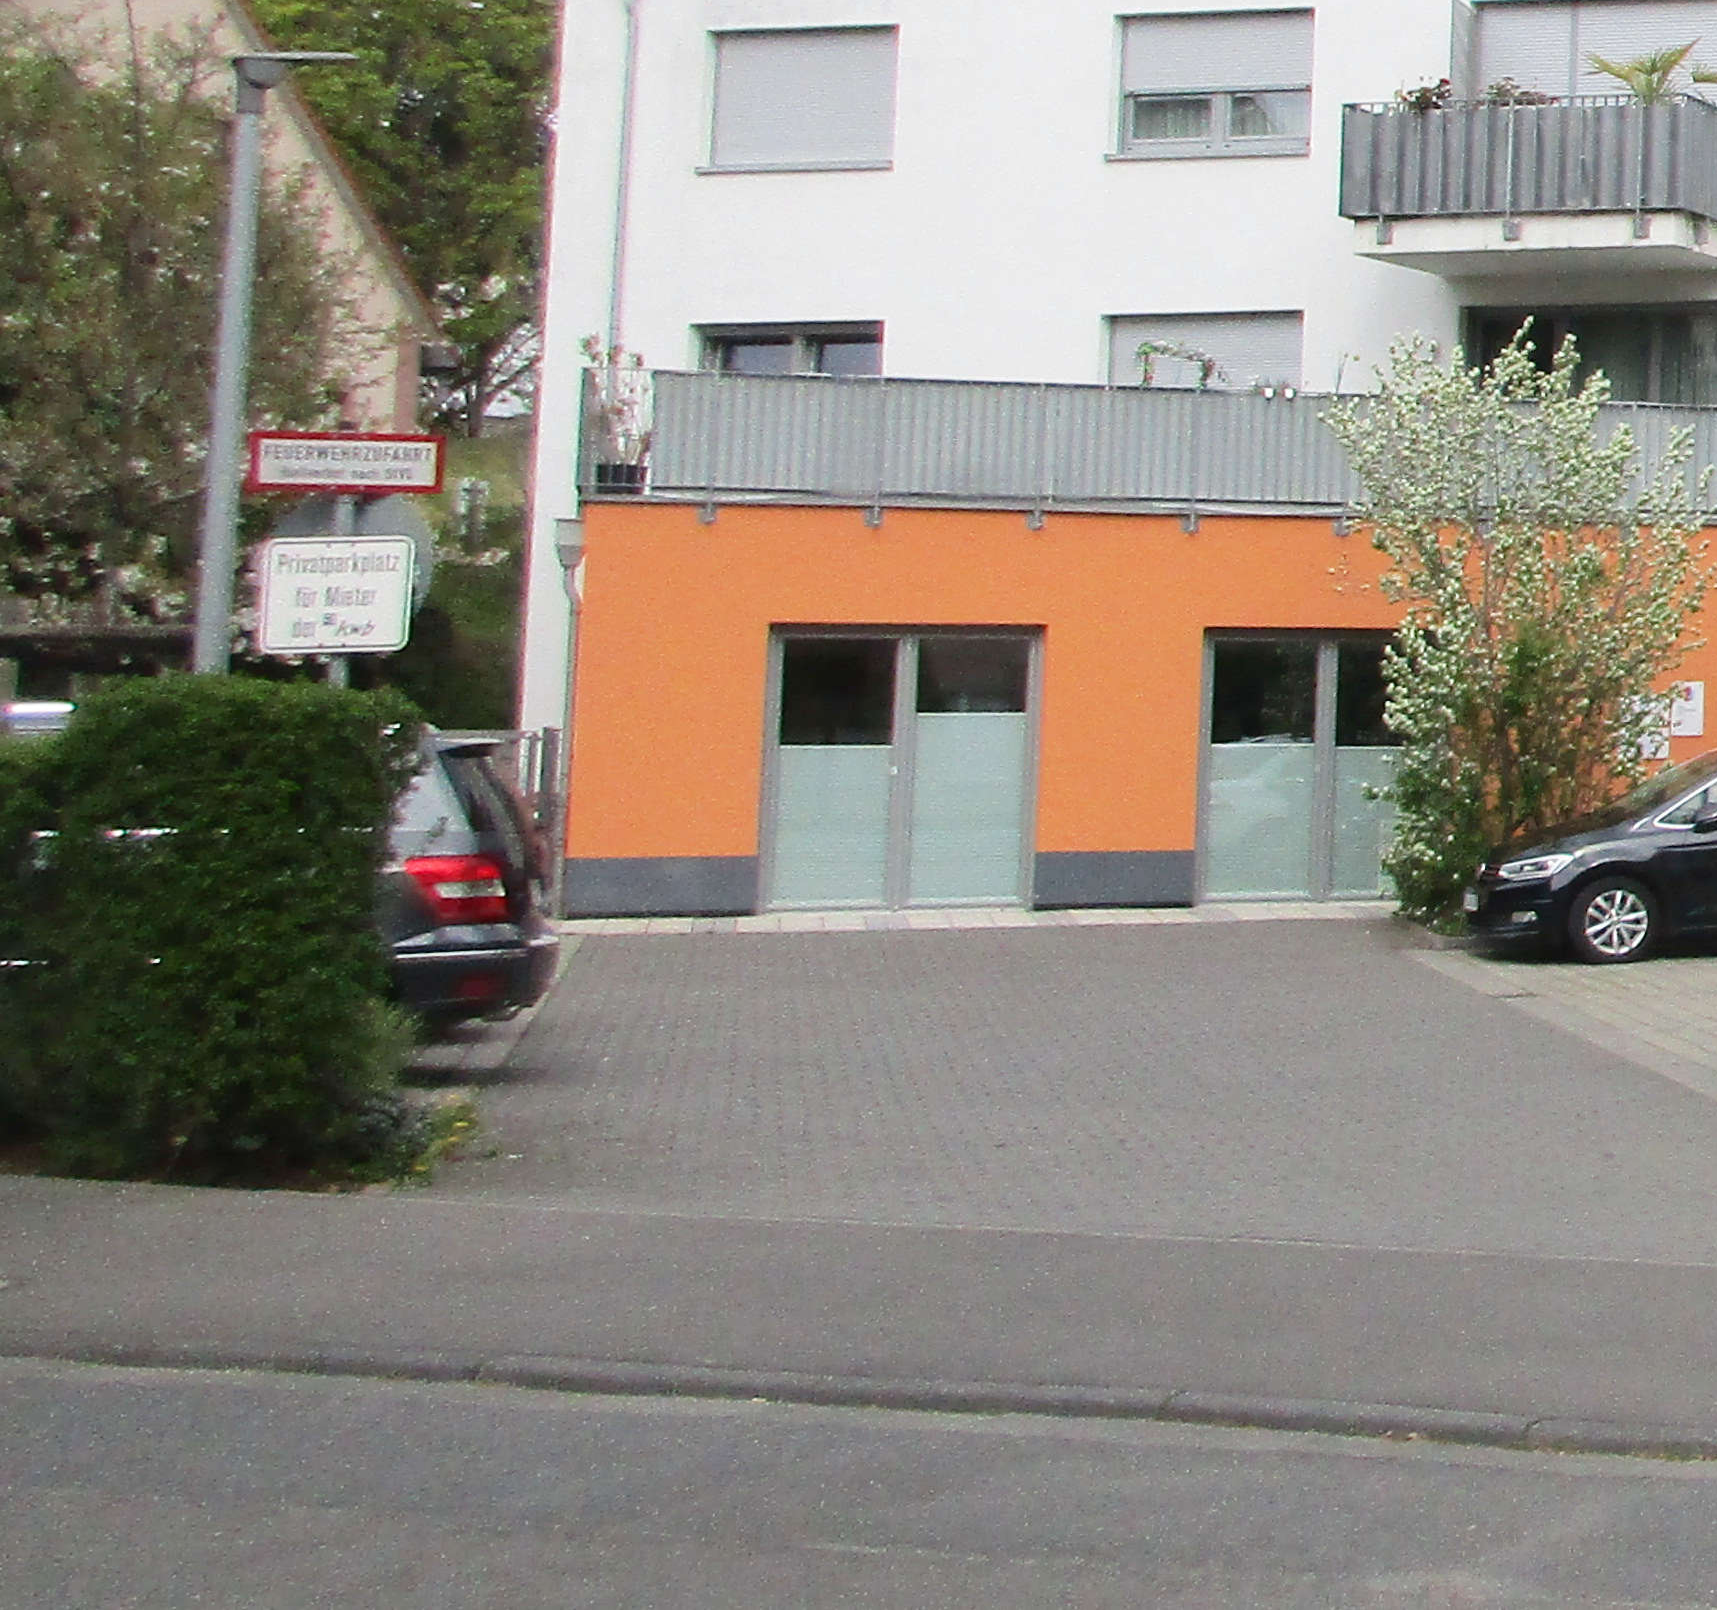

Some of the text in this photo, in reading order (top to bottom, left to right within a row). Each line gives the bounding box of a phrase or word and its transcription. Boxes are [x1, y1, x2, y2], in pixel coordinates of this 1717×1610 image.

[263, 444, 432, 462] FEUERWEHRZUFAHRT
[277, 552, 400, 576] Privatparkplatz
[295, 586, 378, 607] für Mieter
[292, 617, 317, 637] der
